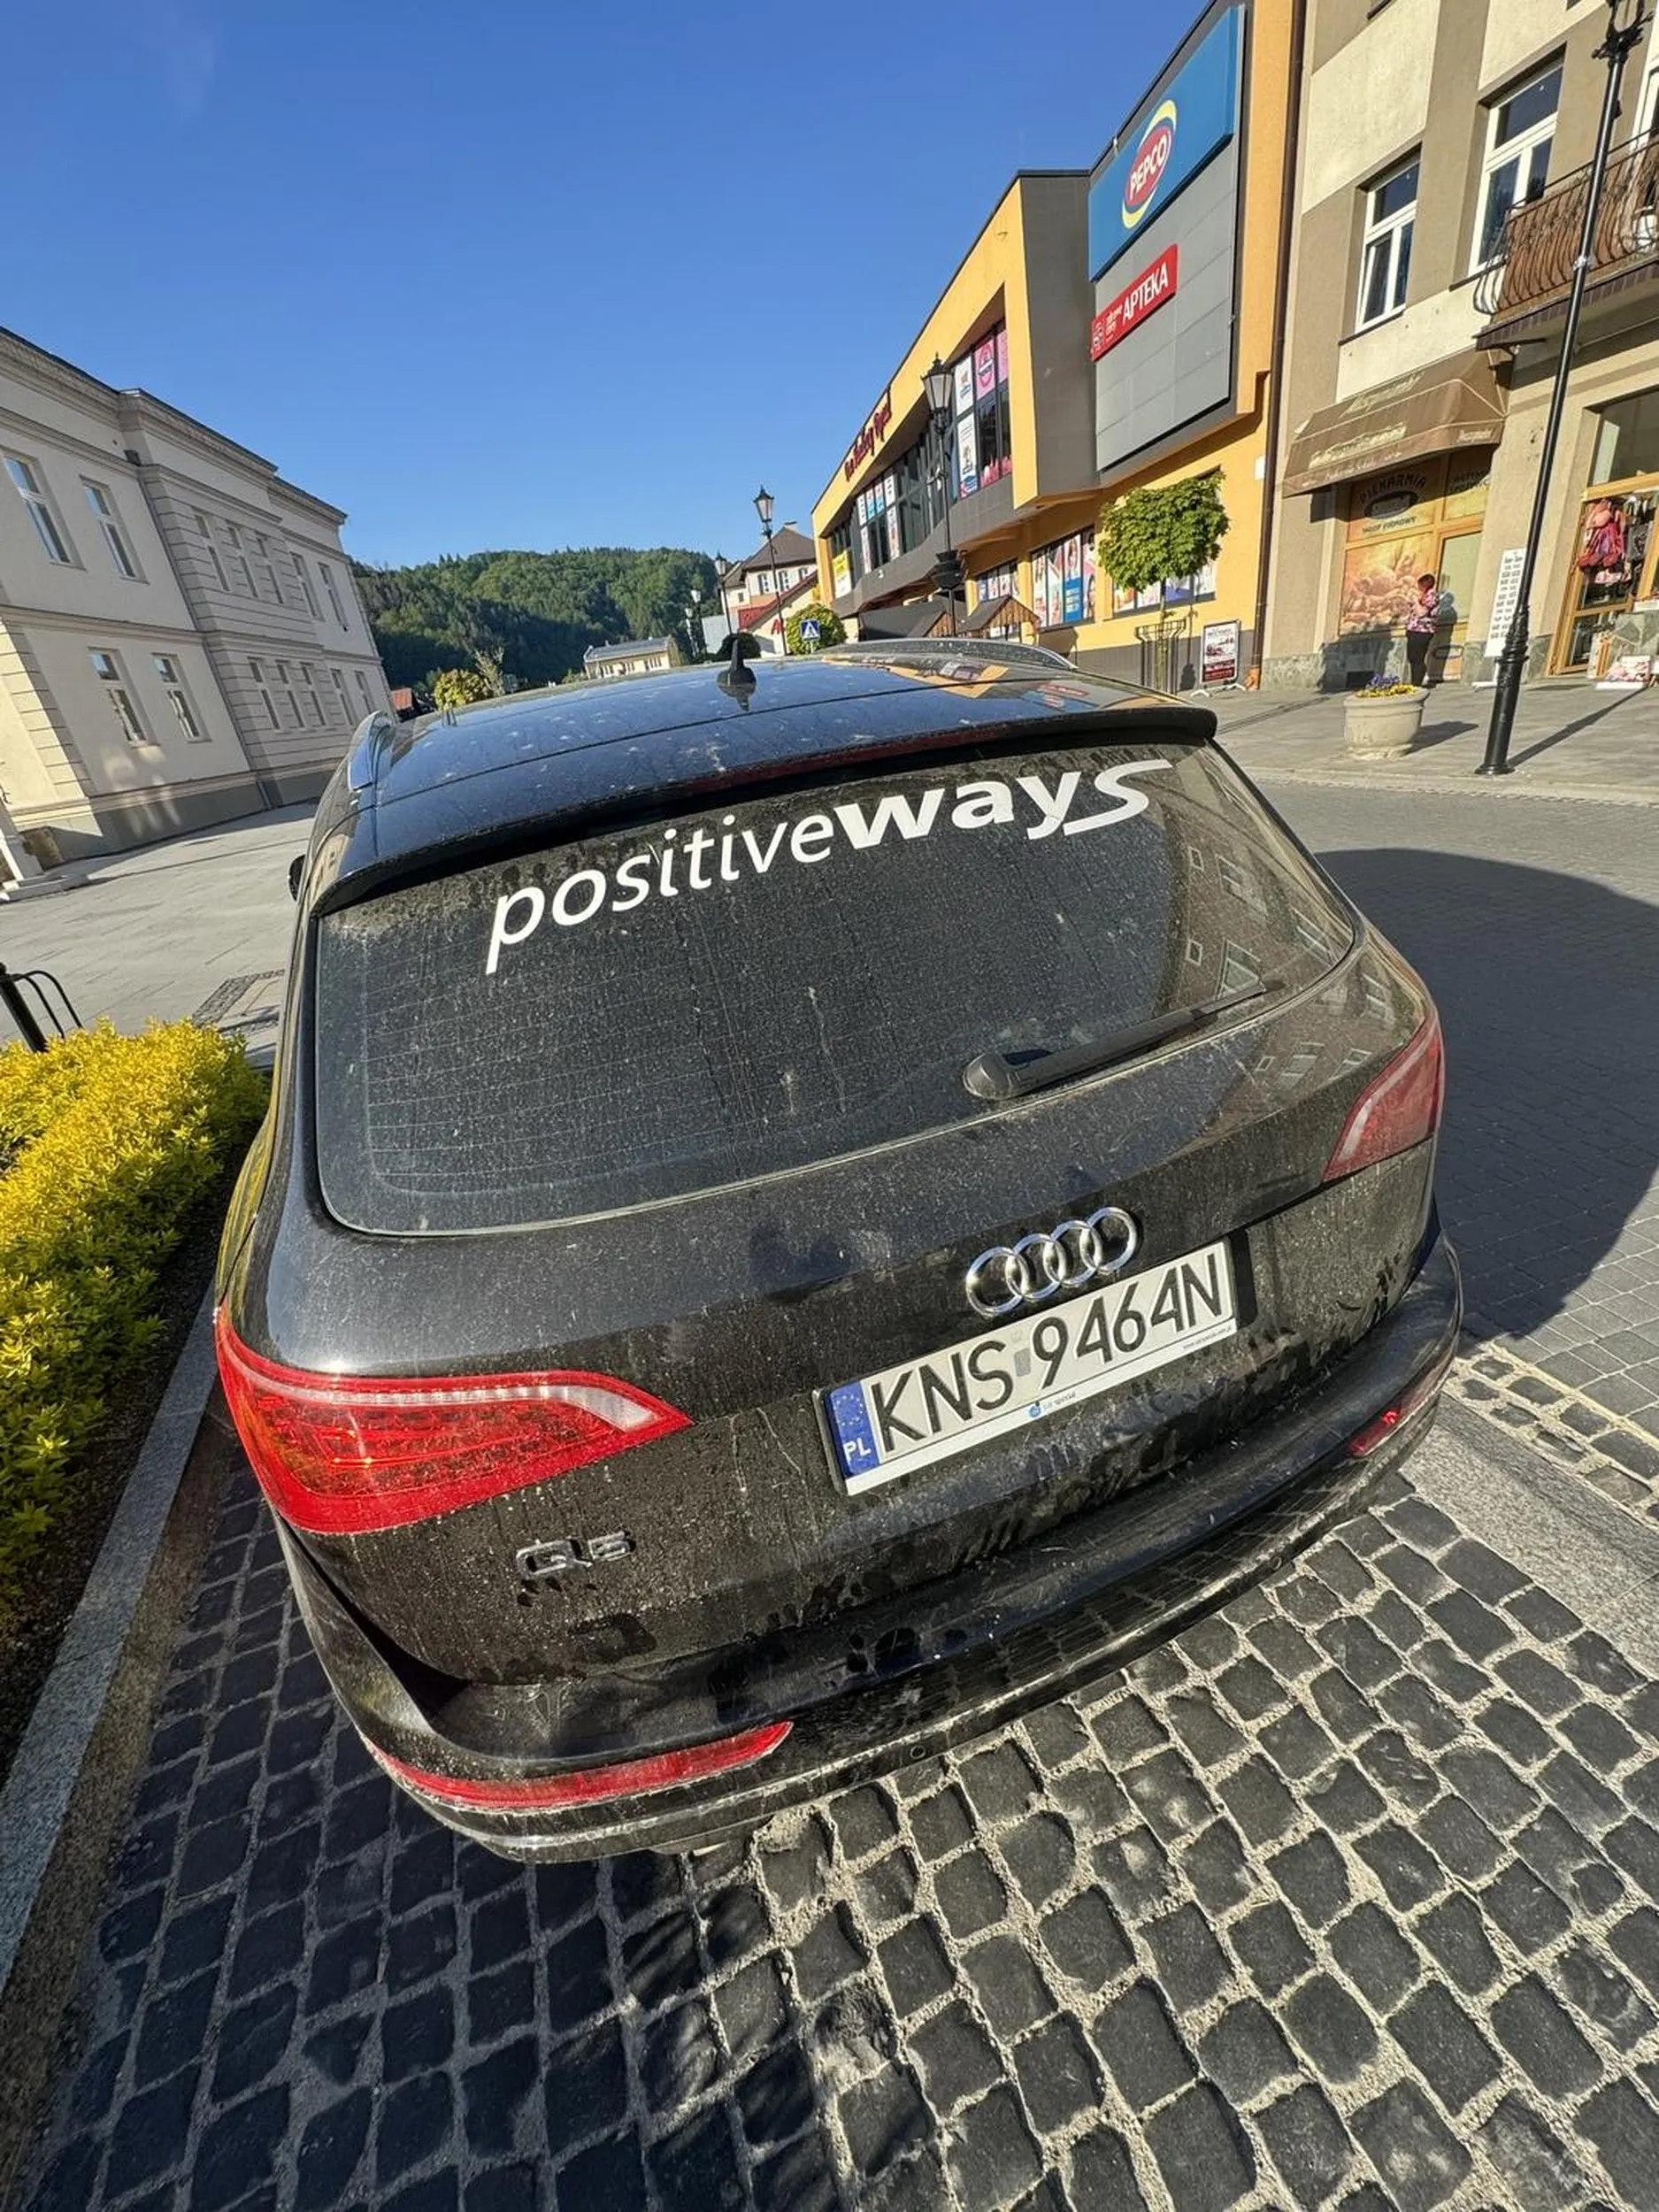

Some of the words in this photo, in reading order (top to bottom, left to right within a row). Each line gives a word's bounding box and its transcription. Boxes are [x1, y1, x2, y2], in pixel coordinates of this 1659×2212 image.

[1129, 134, 1168, 202] PEPCO
[1121, 261, 1169, 326] APTEKA
[486, 758, 1173, 975] positiveways
[872, 1340, 1014, 1453] KNS
[1032, 1253, 1223, 1390] 9464N
[842, 1437, 872, 1465] PL
[517, 1532, 631, 1576] Q5
